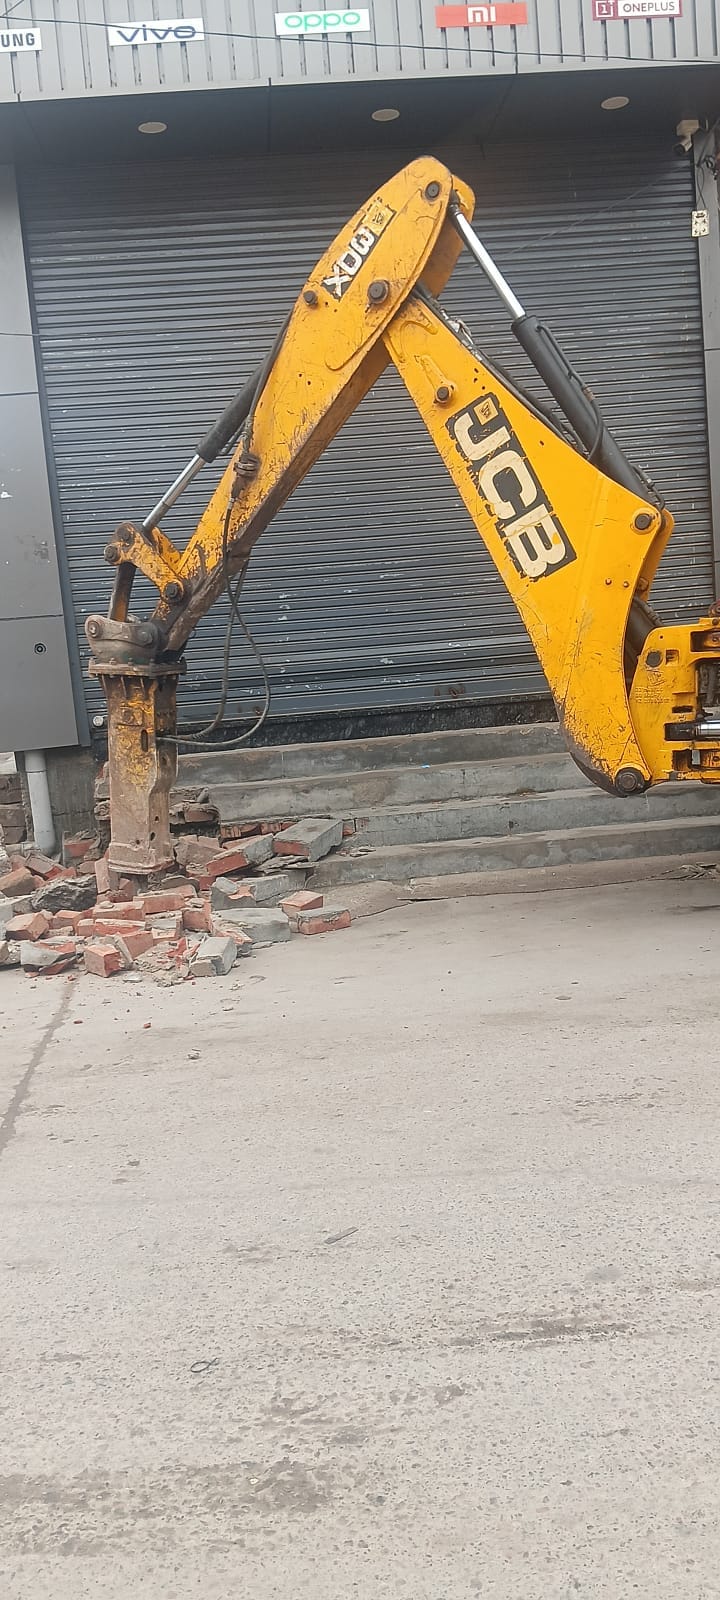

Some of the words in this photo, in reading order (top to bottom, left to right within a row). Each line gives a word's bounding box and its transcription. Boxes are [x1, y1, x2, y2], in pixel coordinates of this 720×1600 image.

[622, 1, 675, 13] ONEPLUS
[284, 12, 361, 32] oppo
[116, 23, 196, 42] vivo
[322, 225, 376, 297] 3DX
[453, 412, 567, 578] JCB
